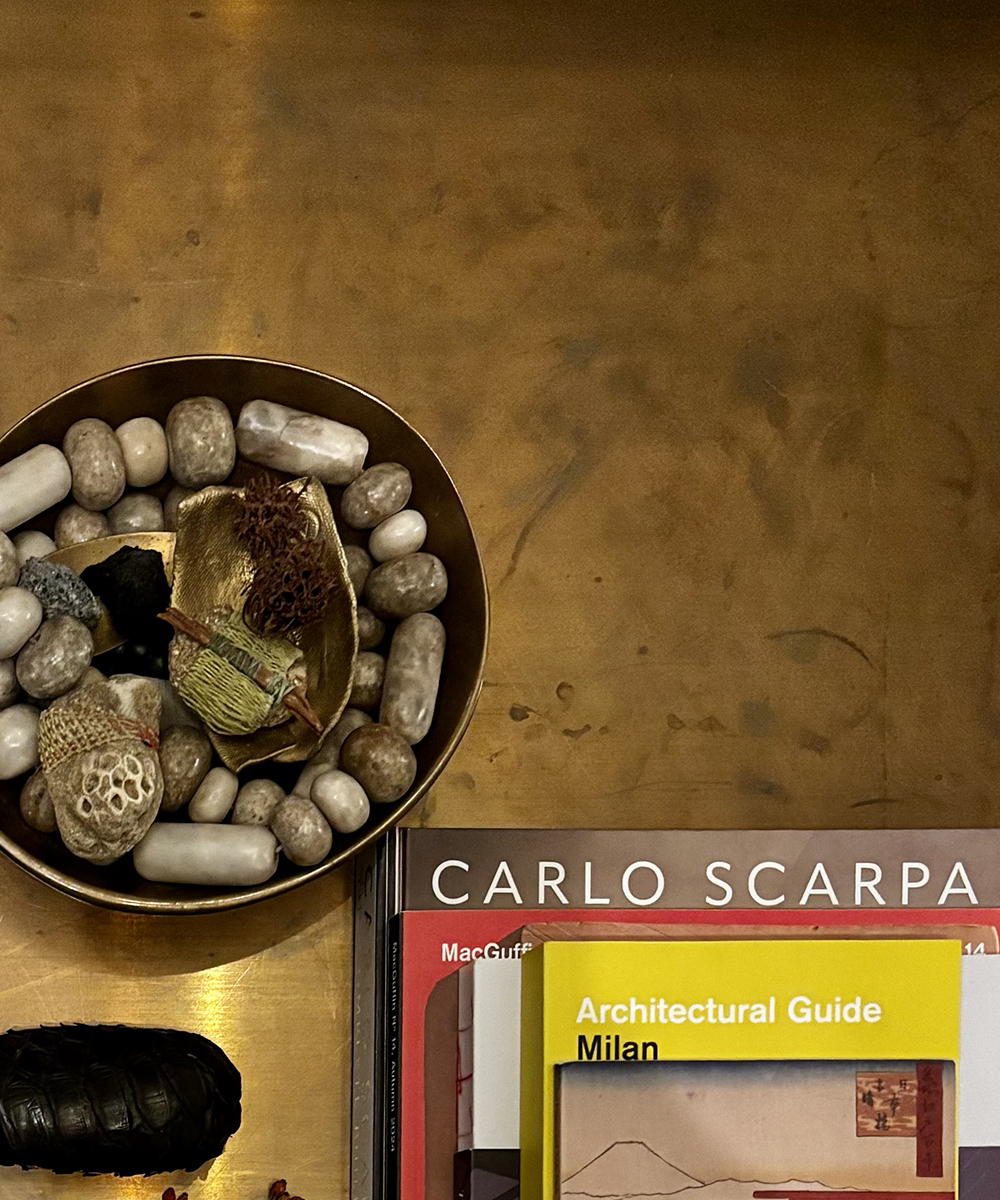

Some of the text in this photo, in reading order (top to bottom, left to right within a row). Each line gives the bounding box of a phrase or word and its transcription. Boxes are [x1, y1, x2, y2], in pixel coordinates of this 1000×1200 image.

[431, 859, 979, 906] CARLO SCARPA
[576, 996, 882, 1024] Architectural Guide
[577, 1034, 659, 1060] Milan
